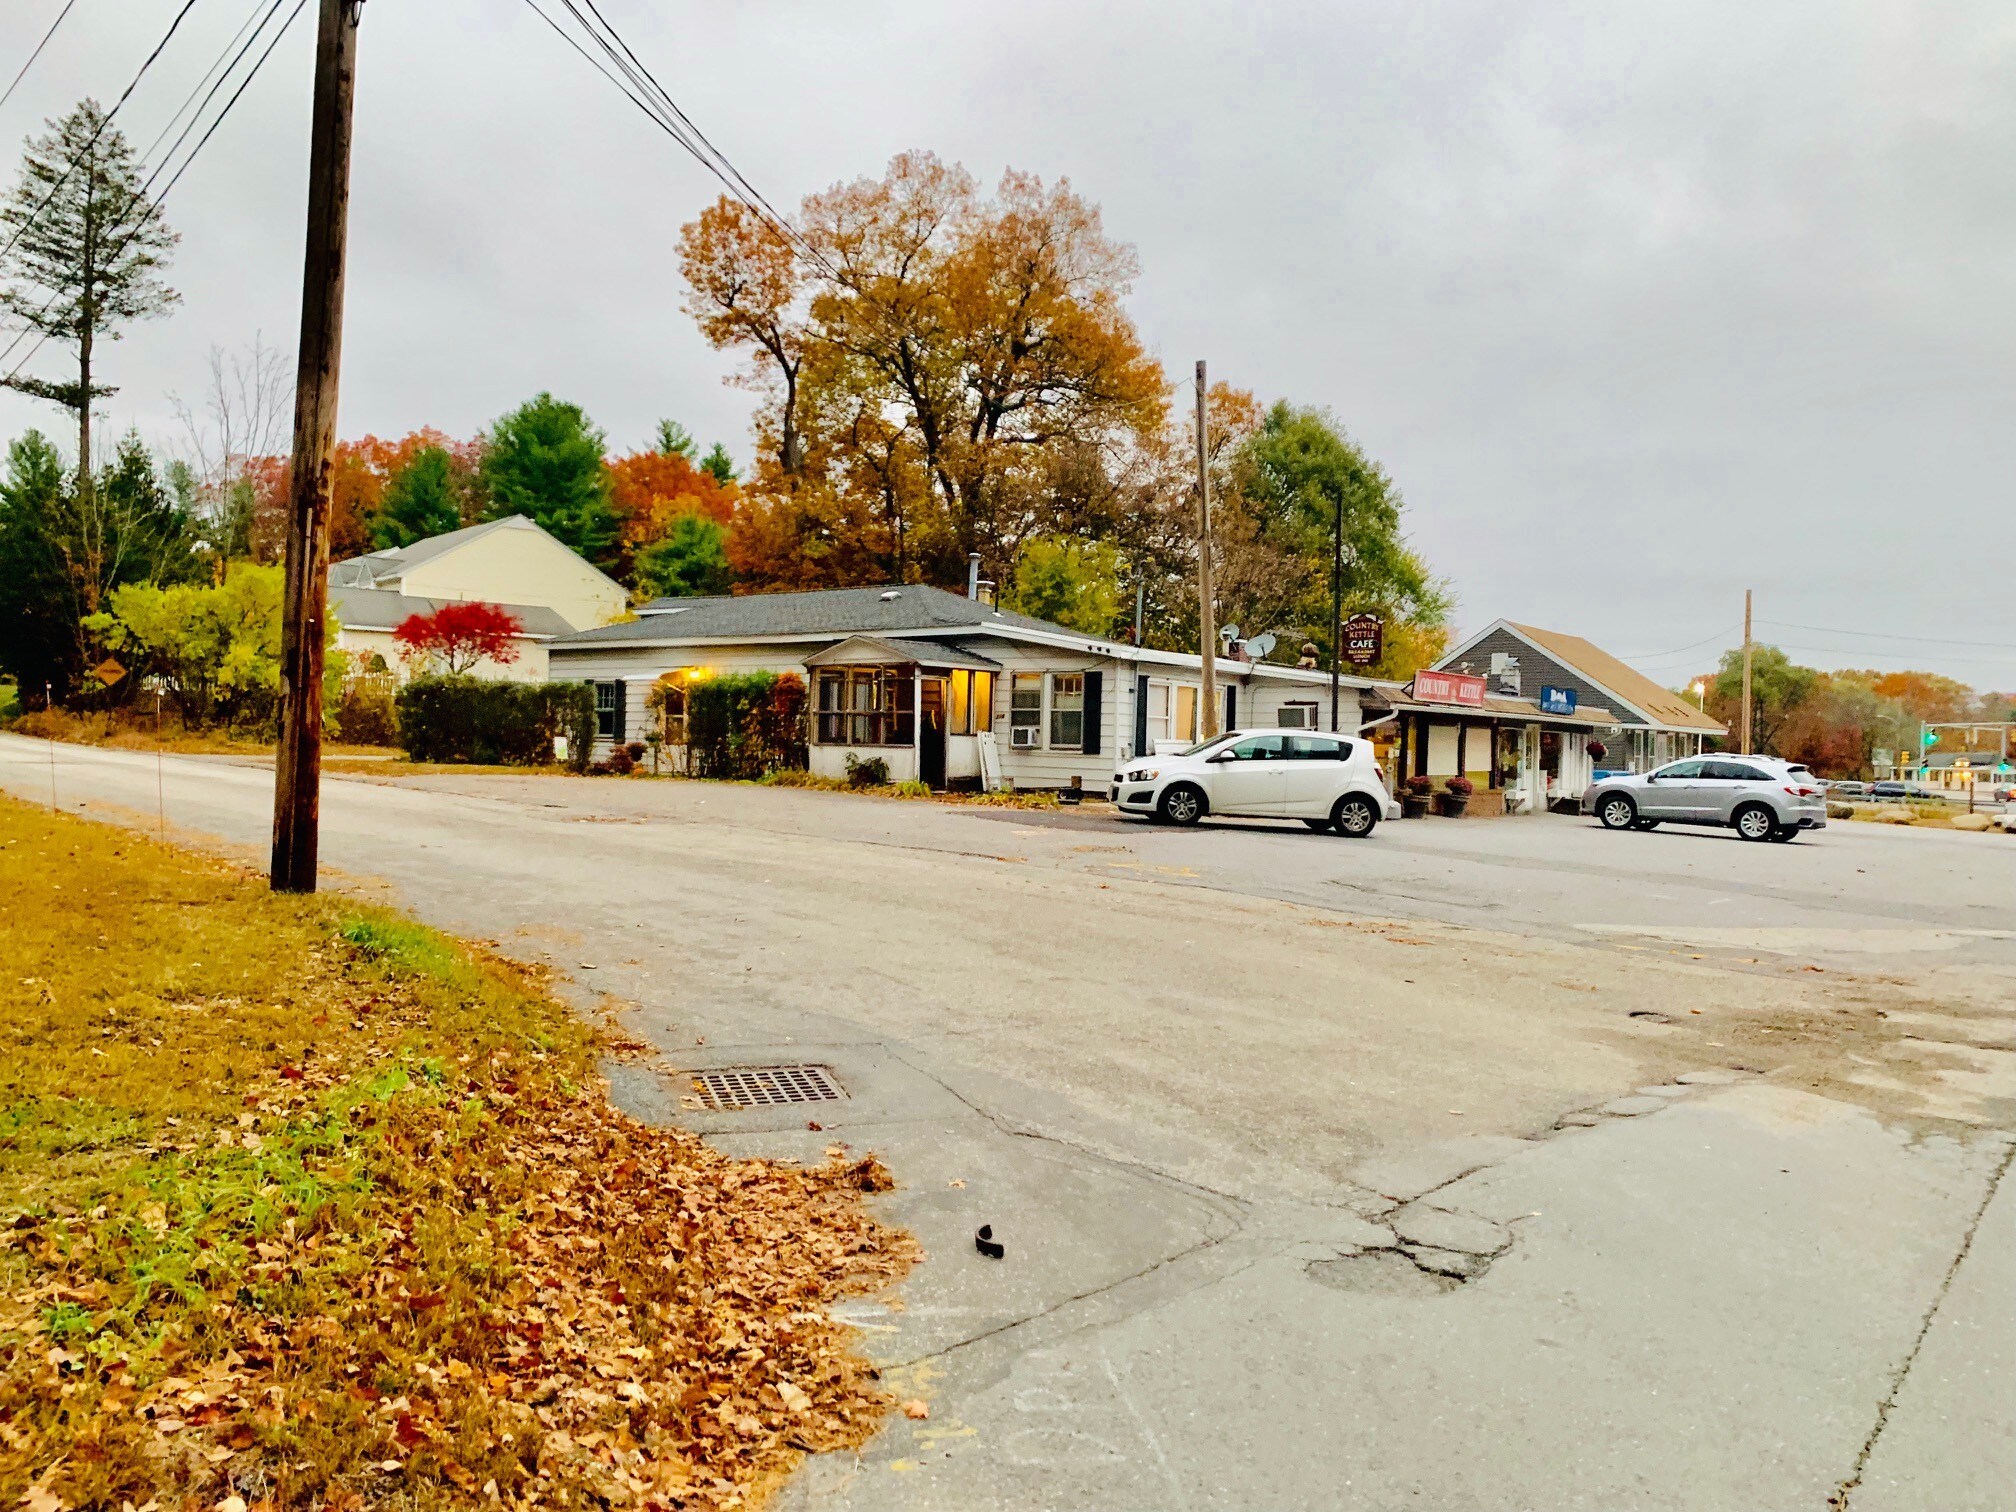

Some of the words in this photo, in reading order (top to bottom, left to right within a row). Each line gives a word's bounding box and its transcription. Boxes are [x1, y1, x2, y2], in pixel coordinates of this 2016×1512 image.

[1345, 621, 1379, 632] COUNTRY
[1349, 630, 1375, 638] KETTLE
[1419, 677, 1451, 696] COUNTRY
[1459, 682, 1482, 699] KETTLE
